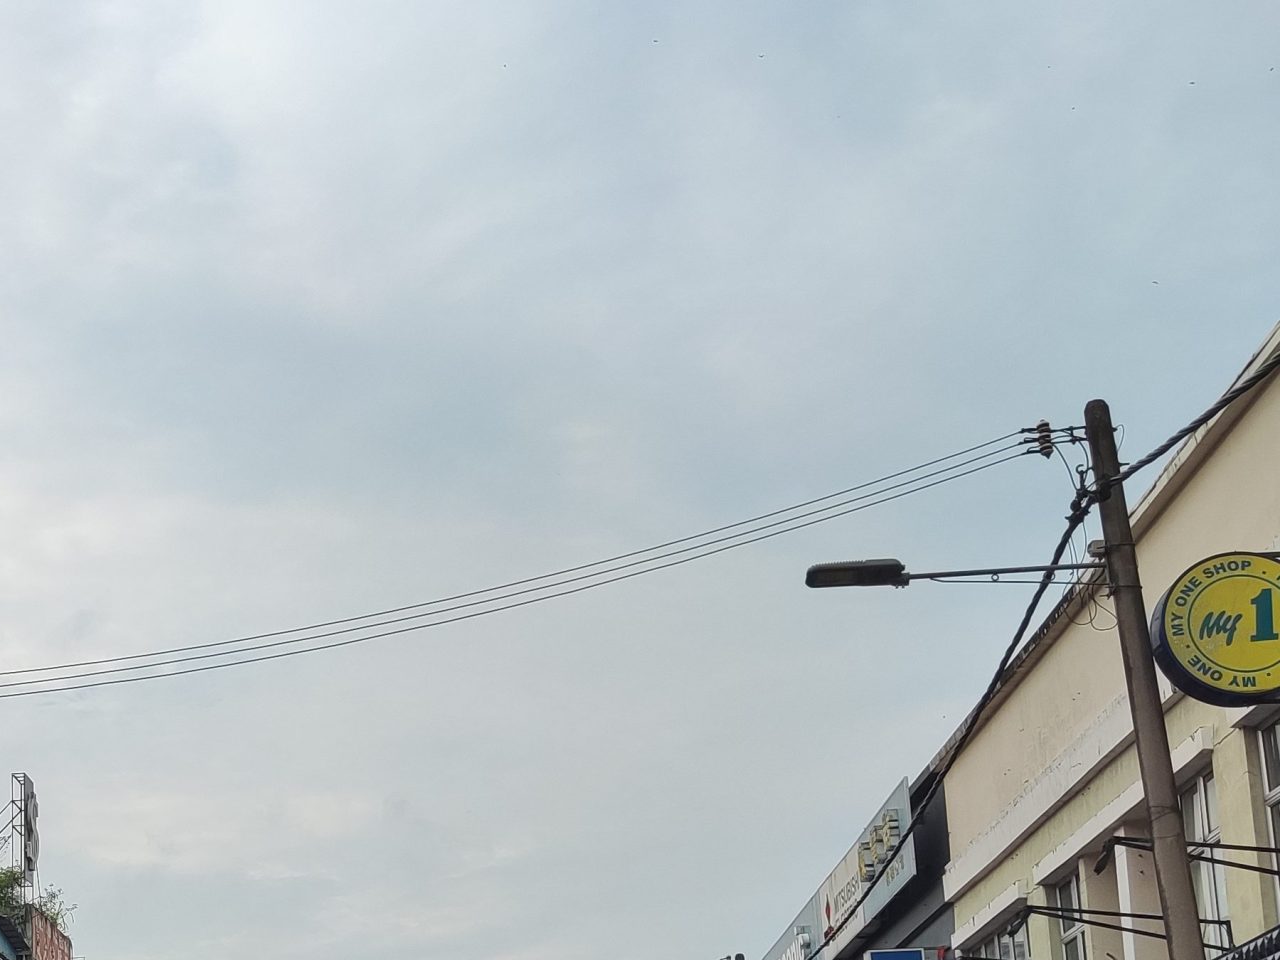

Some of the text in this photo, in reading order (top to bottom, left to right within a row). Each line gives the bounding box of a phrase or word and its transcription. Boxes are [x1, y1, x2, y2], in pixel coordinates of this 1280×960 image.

[1171, 560, 1252, 637] MY ONE SHOP
[1199, 588, 1279, 647] My 1
